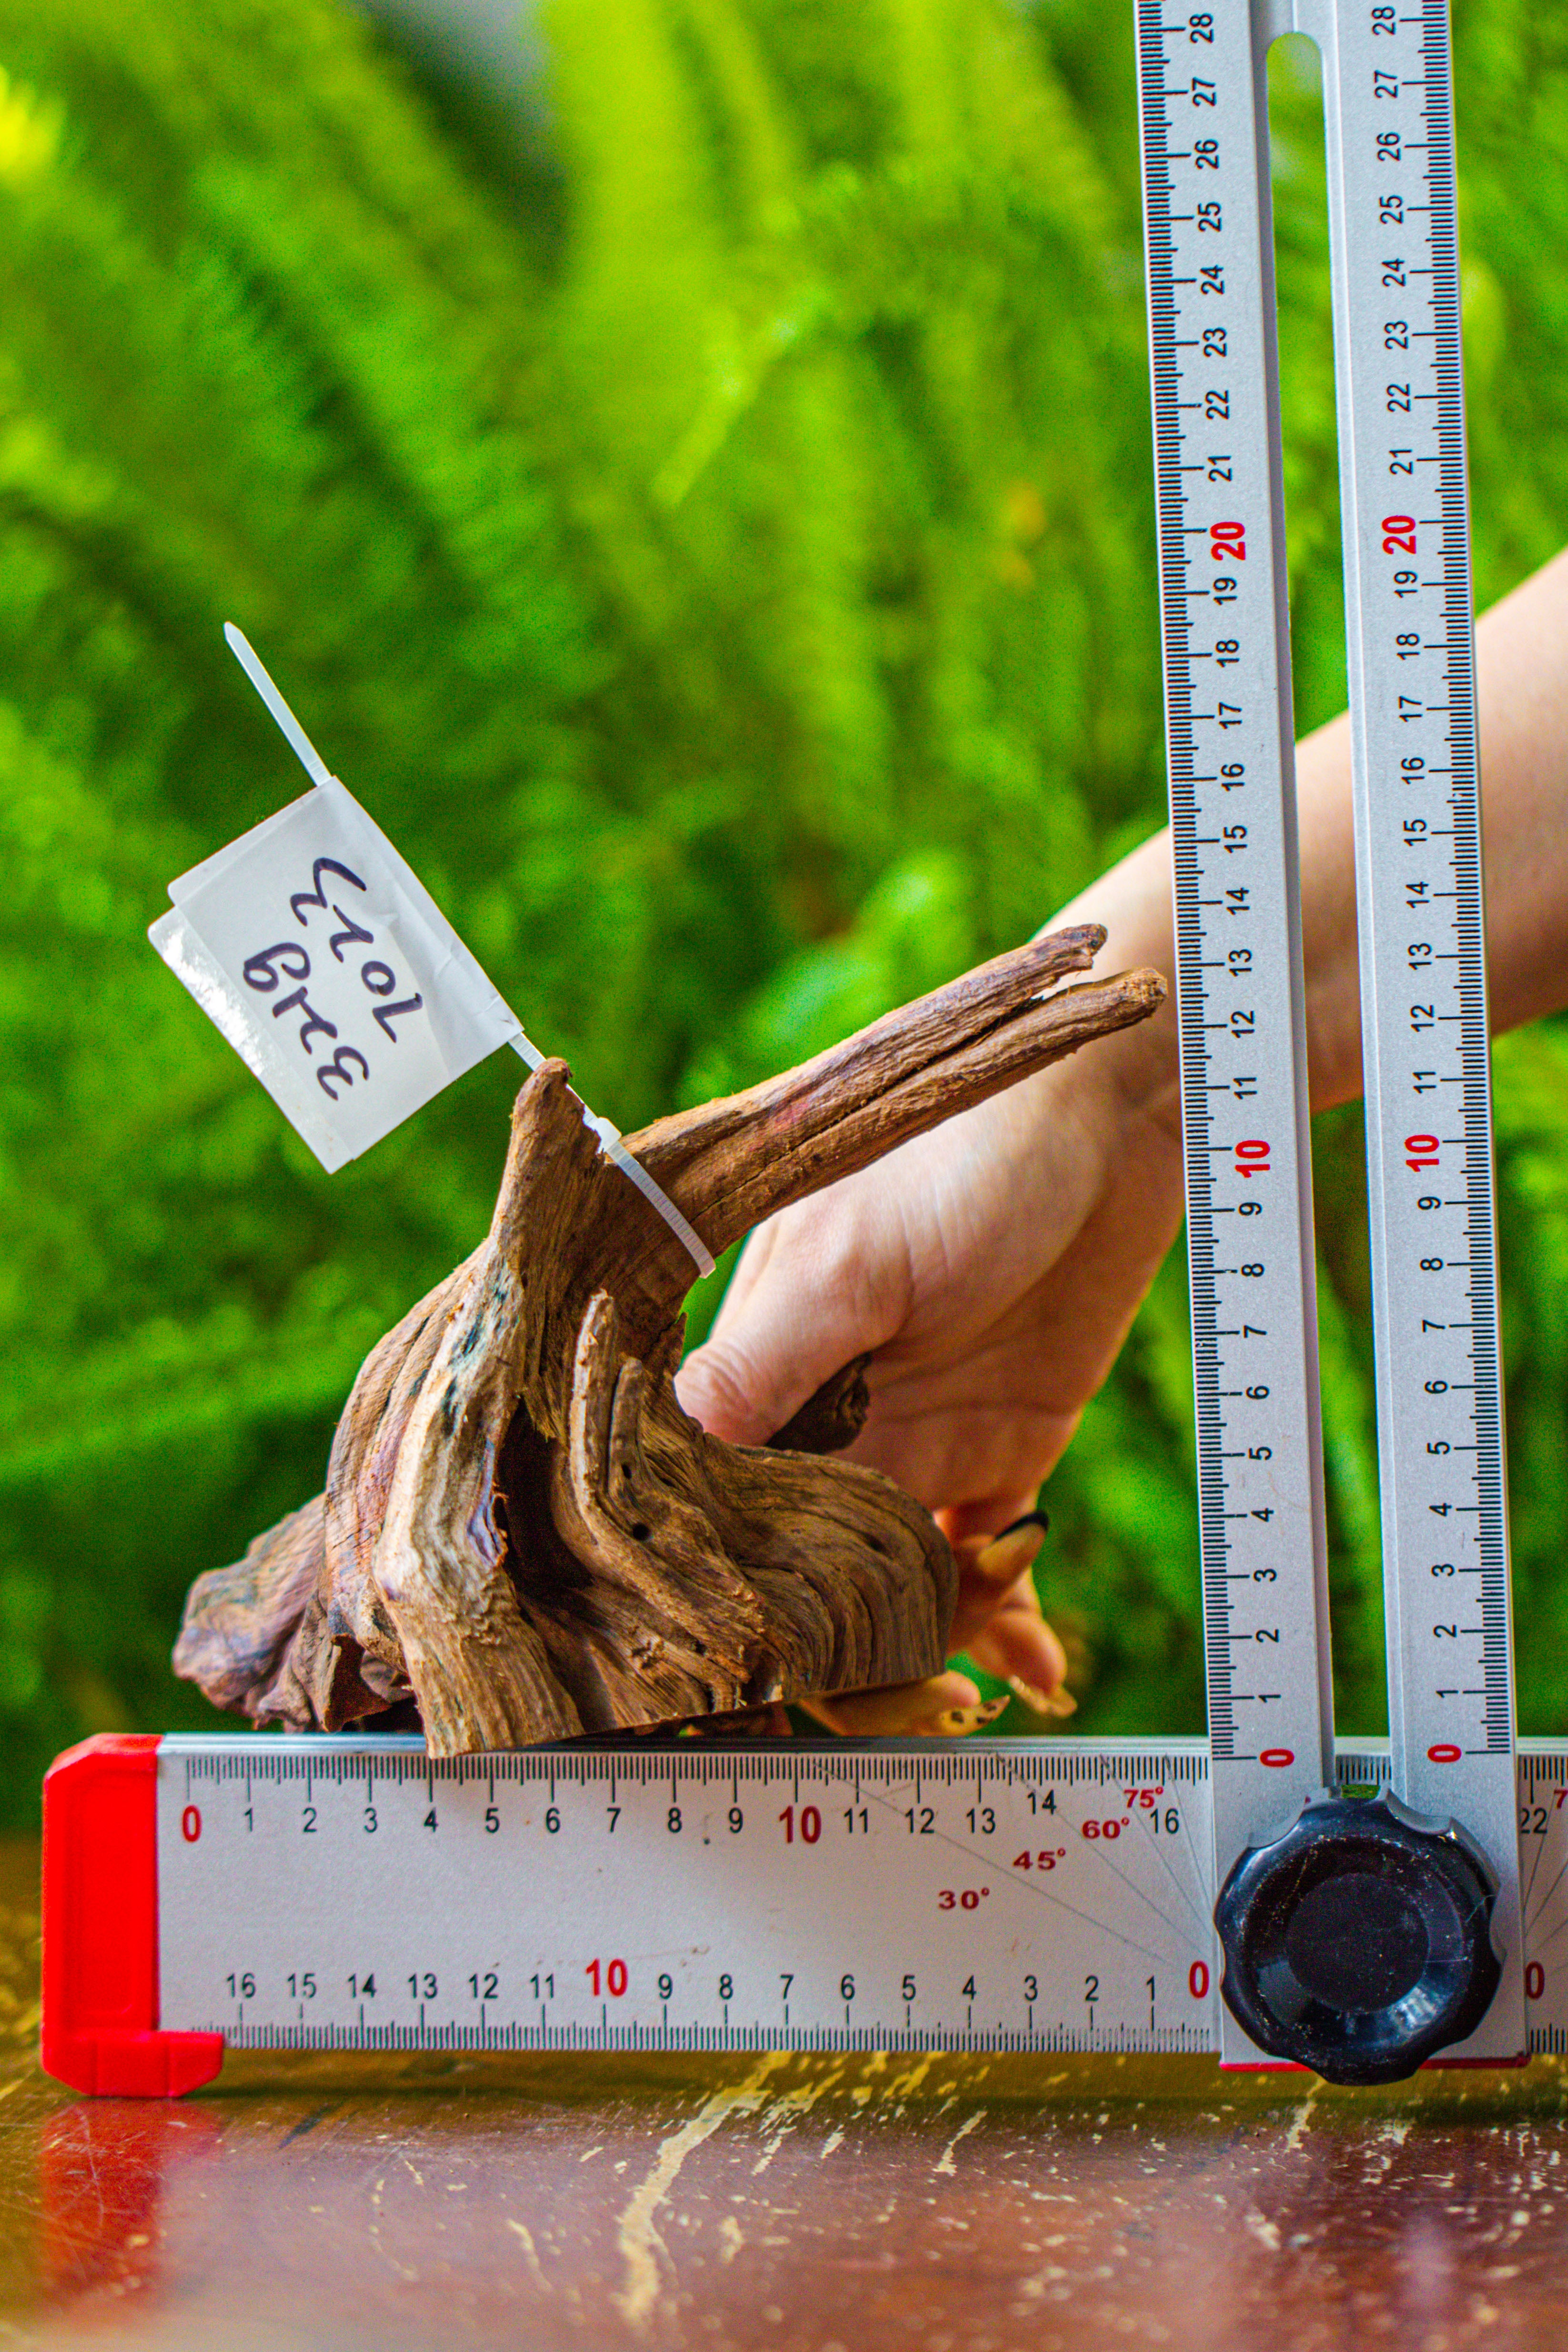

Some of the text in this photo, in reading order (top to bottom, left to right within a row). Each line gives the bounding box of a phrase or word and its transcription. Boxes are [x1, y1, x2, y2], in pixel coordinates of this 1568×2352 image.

[1189, 14, 1295, 1767] 0 1 2 3 4 5 6 7 8 9 10 11 12 13 14 15 16 17 18 19 20 21 22 23 24 25 26 27 28
[1371, 7, 1462, 1763] 0 1 2 3 4 5 6 7 8 9 10 11 12 13 14 15 16 17 18 19 20 21 22 23 24 25 26 27 28
[289, 857, 424, 1043] 7023
[182, 1790, 1547, 1844] 0 1 2 3 4 5 6 7 8 9 10 11 12 13 14 16 22
[1124, 1787, 1163, 1808] 75°
[1082, 1818, 1129, 1839] 60°
[1014, 1848, 1065, 1870] 45°
[940, 1888, 989, 1909] 30°
[227, 1959, 1545, 2001] 16 15 14 13 12 11 10 9 8 7 6 5 4 3 2 1 0 0
